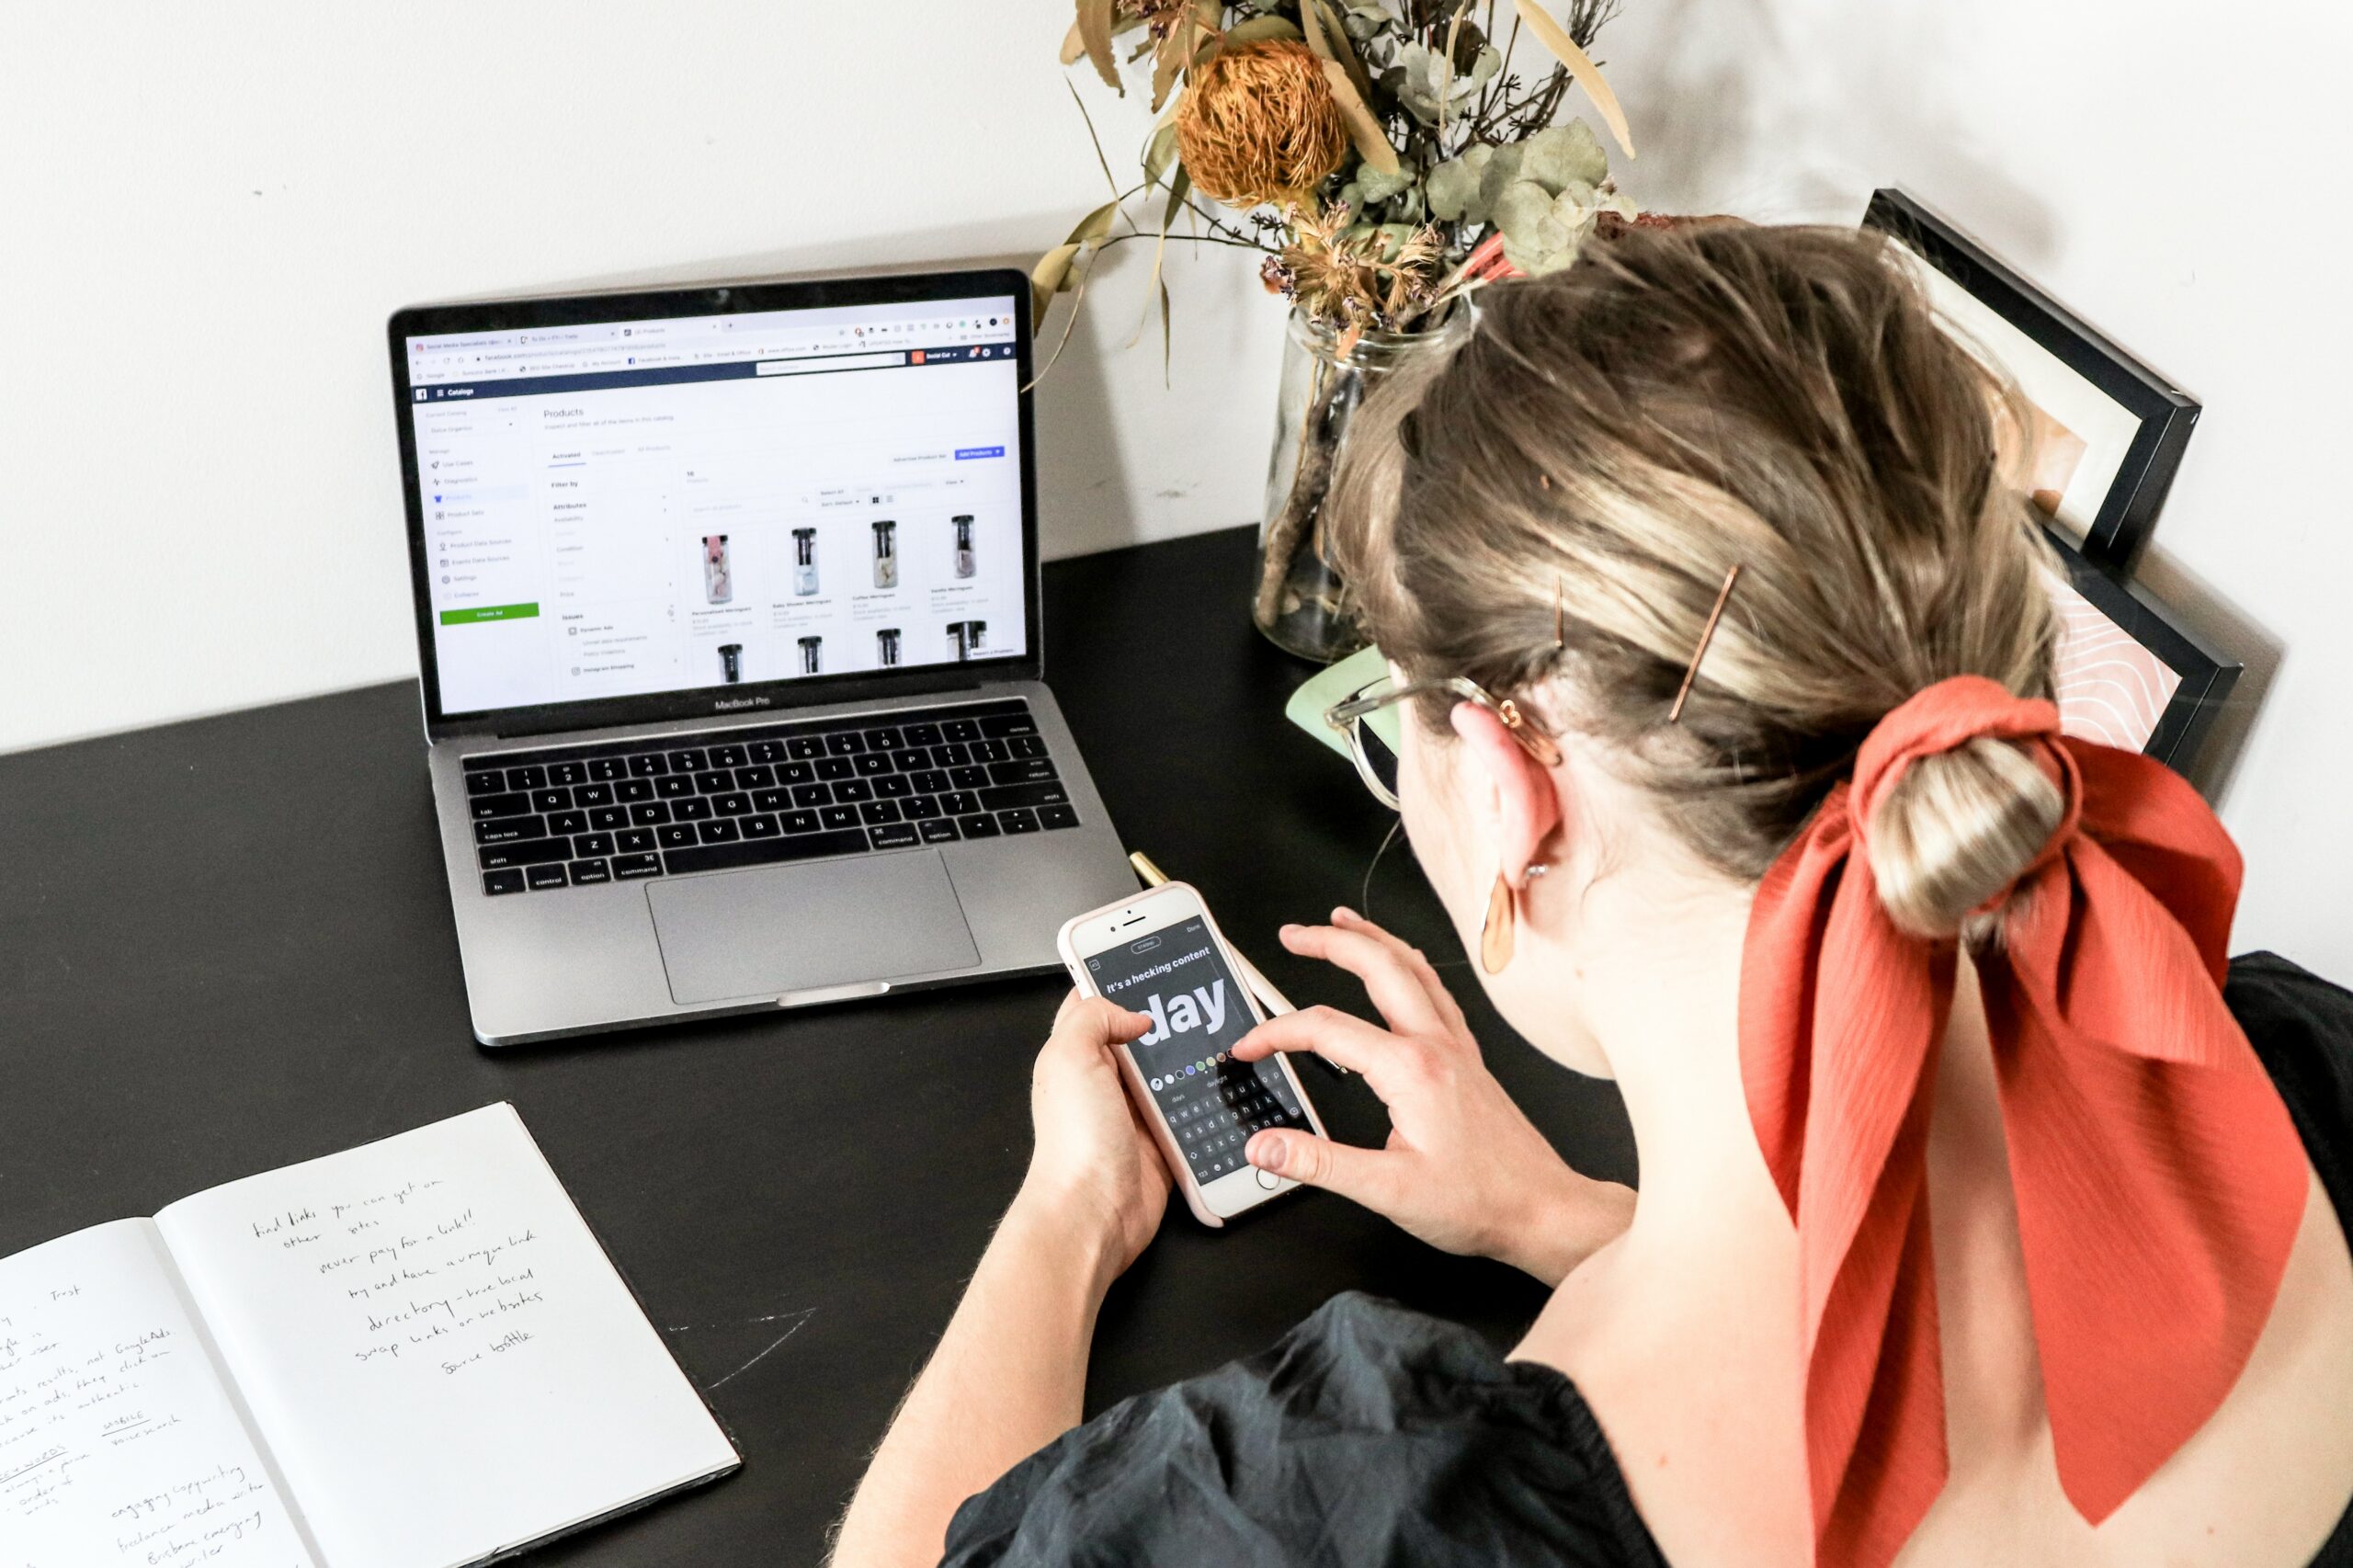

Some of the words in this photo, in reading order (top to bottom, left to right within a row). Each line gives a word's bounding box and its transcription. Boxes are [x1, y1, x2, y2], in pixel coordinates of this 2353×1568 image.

[448, 388, 473, 396] Catalogs
[543, 408, 584, 418] Products
[553, 502, 586, 510] Attributes
[715, 699, 754, 708] MacBook
[756, 697, 770, 705] Pro
[621, 867, 657, 875] command
[1187, 924, 1201, 932] Done
[1107, 982, 1123, 994] It's
[1132, 963, 1172, 984] hecking
[1173, 947, 1211, 967] content
[1138, 979, 1225, 1046] day
[1207, 1075, 1228, 1088] daylight
[1172, 1095, 1186, 1103] days
[288, 1209, 315, 1226] links
[331, 1204, 351, 1219] you
[363, 1196, 385, 1206] can
[394, 1182, 415, 1204] get
[424, 1180, 443, 1188] on
[284, 1234, 321, 1248] other
[321, 1256, 359, 1273] never
[369, 1247, 397, 1263] pay
[401, 1236, 418, 1248] for
[349, 1289, 369, 1299] try
[375, 1274, 397, 1290] and
[404, 1269, 438, 1278] have
[509, 1230, 537, 1245] link
[51, 1285, 81, 1301] Trust
[368, 1300, 455, 1331] directory
[498, 1269, 534, 1285] local
[356, 1343, 398, 1361] swap
[460, 1318, 473, 1327] on
[489, 1331, 535, 1352] bottle
[87, 1351, 103, 1365] not
[22, 1406, 37, 1415] on
[120, 1357, 146, 1372] click
[184, 1499, 225, 1519] media
[204, 1511, 261, 1539] emerging
